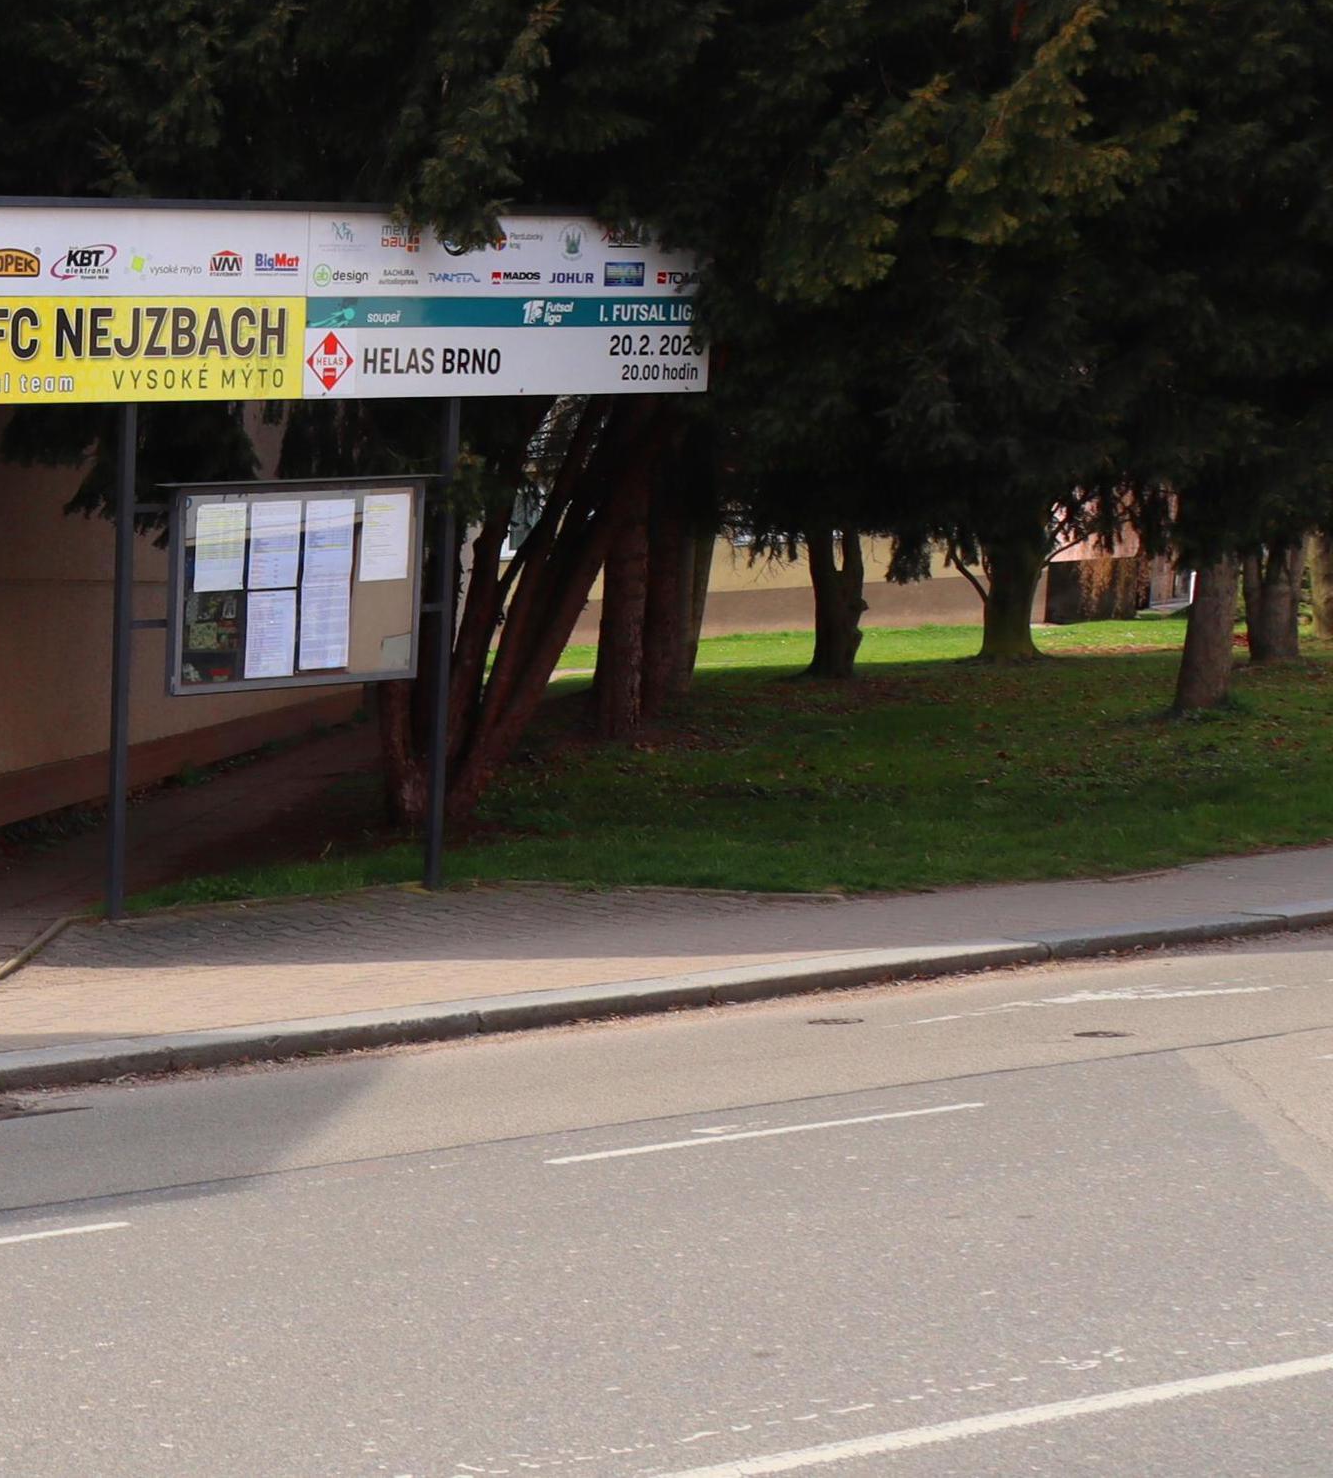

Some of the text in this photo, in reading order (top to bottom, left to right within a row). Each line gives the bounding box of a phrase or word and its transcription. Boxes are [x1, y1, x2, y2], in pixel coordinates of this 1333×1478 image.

[66, 250, 104, 267] KBT
[255, 253, 299, 269] BigMat
[149, 264, 202, 276] vysoké mýto
[332, 270, 369, 283] design
[503, 272, 541, 280] MADOS
[549, 272, 594, 284] JOHUR
[613, 304, 666, 321] FUTSAL
[670, 304, 697, 321] LIG
[54, 306, 288, 361] NEJZBACH
[609, 334, 654, 356] 20.2.
[316, 358, 344, 366] HELAS
[363, 347, 501, 375] HELAS BRNO
[112, 362, 284, 390] VYSOKÉ MÝTO
[621, 362, 698, 380] 20.00 hodin
[20, 374, 74, 393] team
